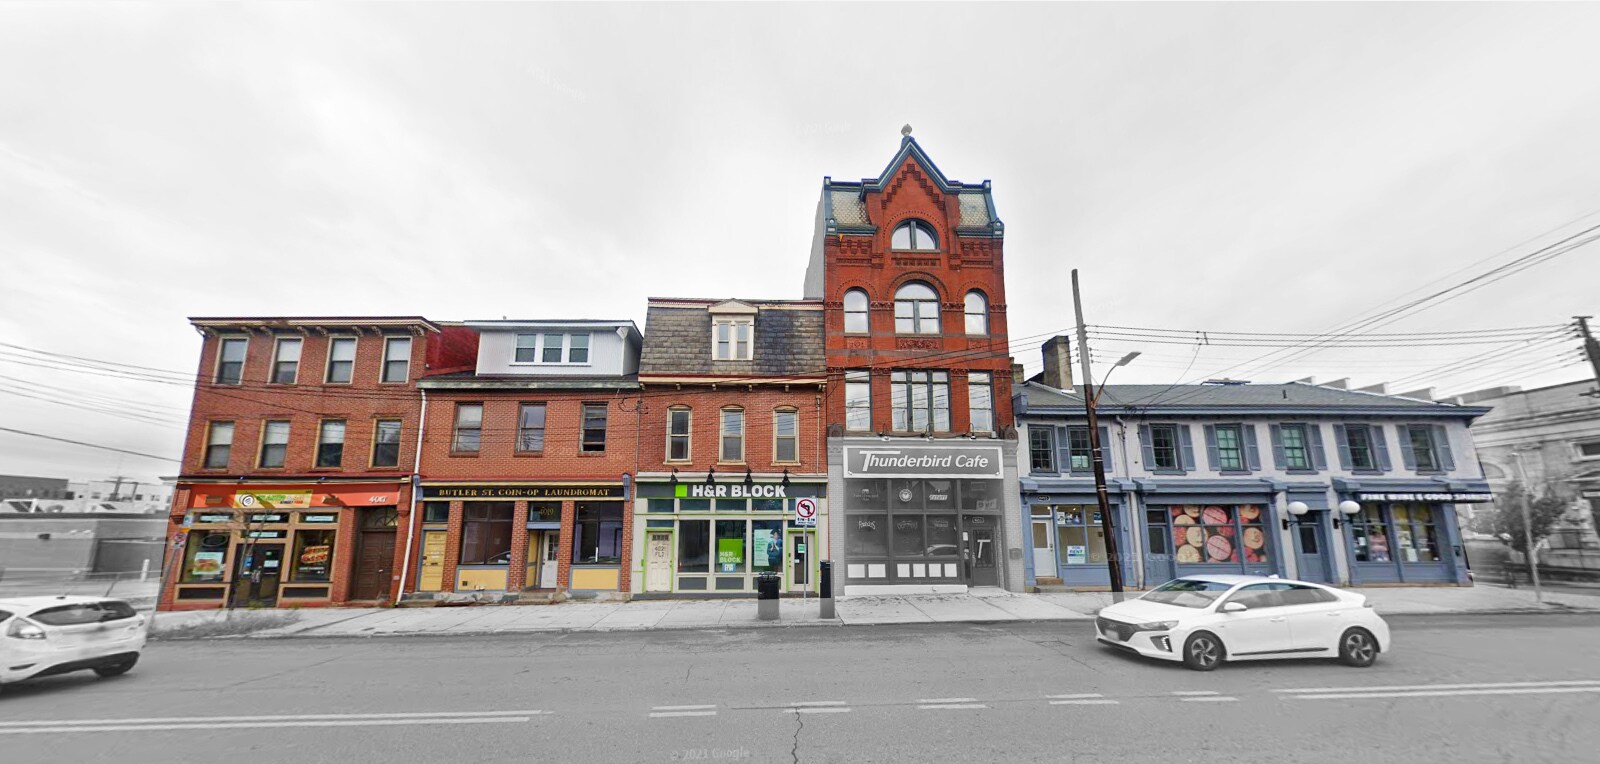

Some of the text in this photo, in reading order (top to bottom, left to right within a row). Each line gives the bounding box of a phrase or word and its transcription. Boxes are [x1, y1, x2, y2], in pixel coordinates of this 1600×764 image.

[859, 451, 988, 471] Thunderbird Cafe
[692, 485, 786, 497] H&R BLOCK
[977, 539, 991, 558] T
